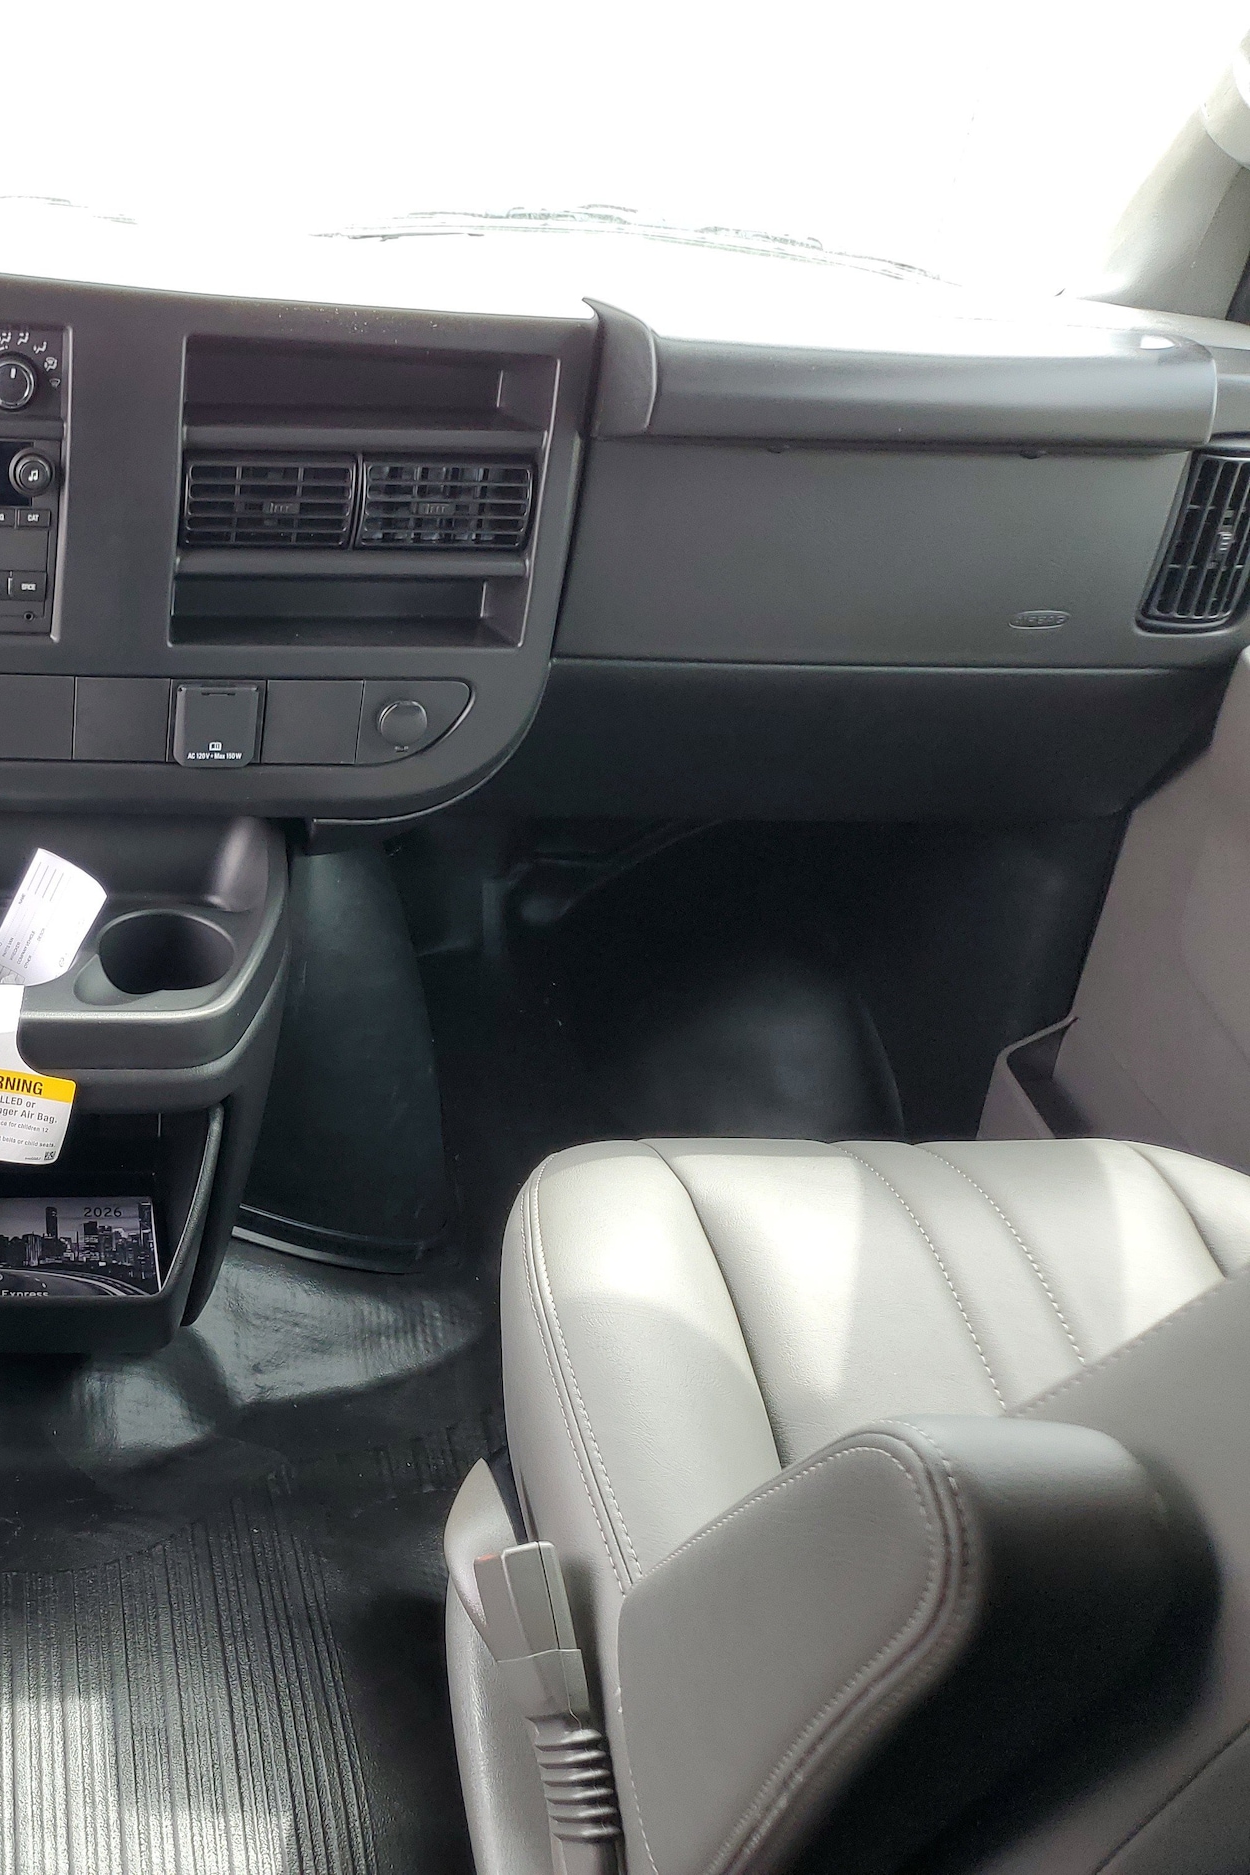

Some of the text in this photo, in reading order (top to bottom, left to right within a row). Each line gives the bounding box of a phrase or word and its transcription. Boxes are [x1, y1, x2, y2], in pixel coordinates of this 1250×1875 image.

[25, 1100, 36, 1108] or
[20, 1110, 34, 1119] Air
[37, 1113, 57, 1124] Bag.
[18, 1123, 40, 1132] children
[84, 1207, 122, 1217] 2026
